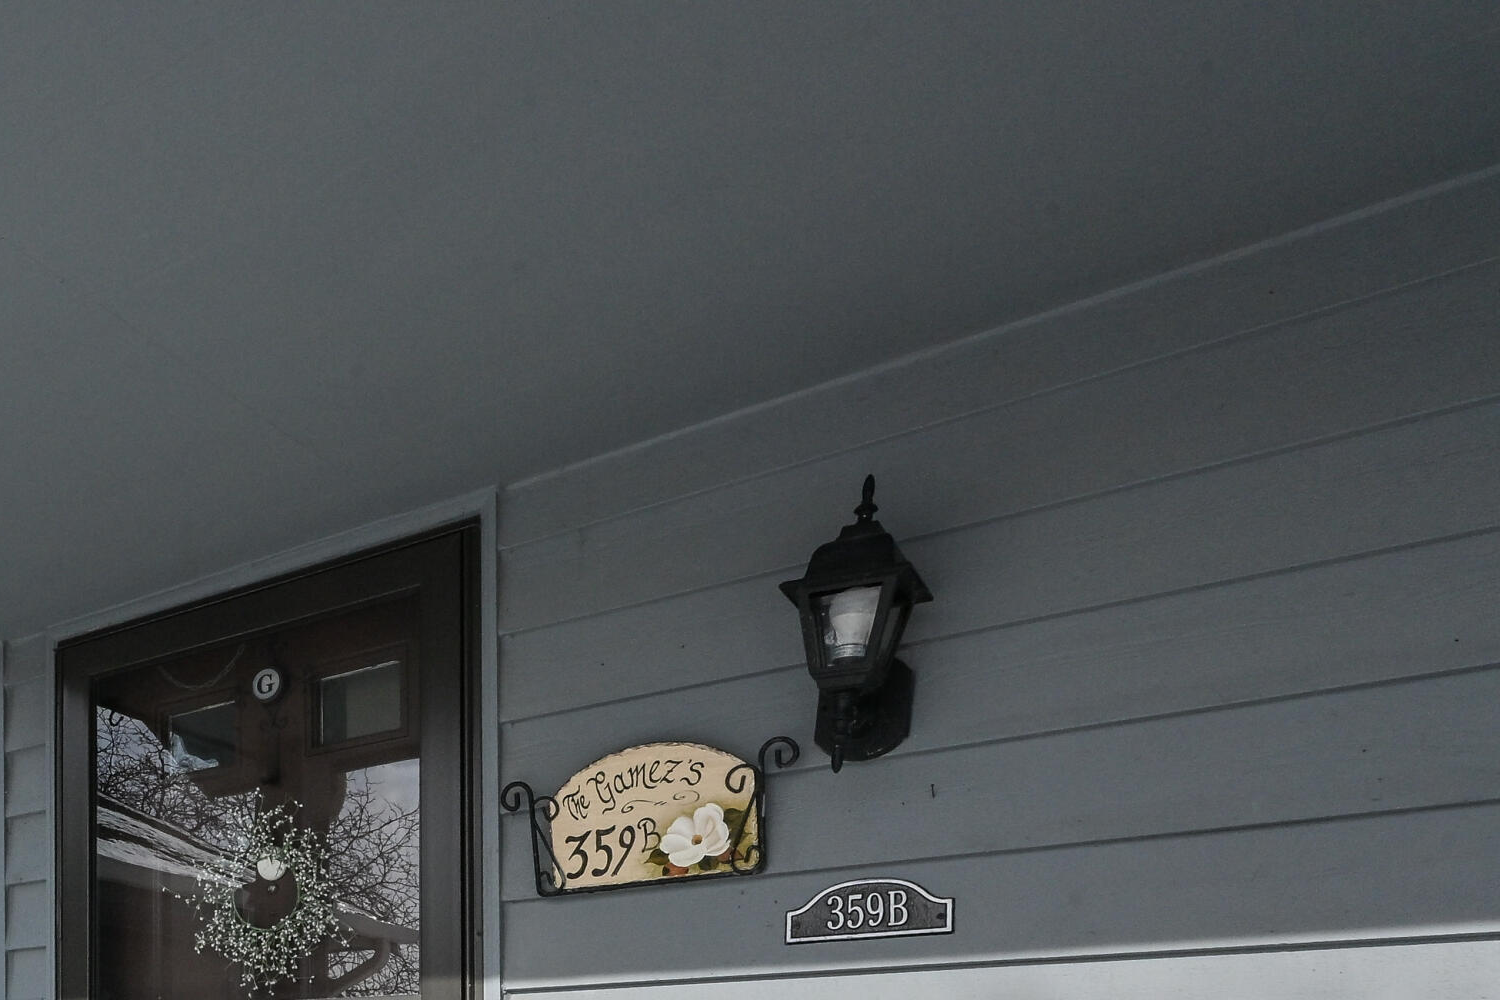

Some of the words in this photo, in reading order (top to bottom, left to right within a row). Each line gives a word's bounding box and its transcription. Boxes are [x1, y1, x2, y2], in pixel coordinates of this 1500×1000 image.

[257, 674, 275, 694] G
[563, 785, 590, 820] The
[587, 759, 705, 814] Gamez's
[565, 817, 661, 880] 359B
[827, 890, 908, 930] 359B
